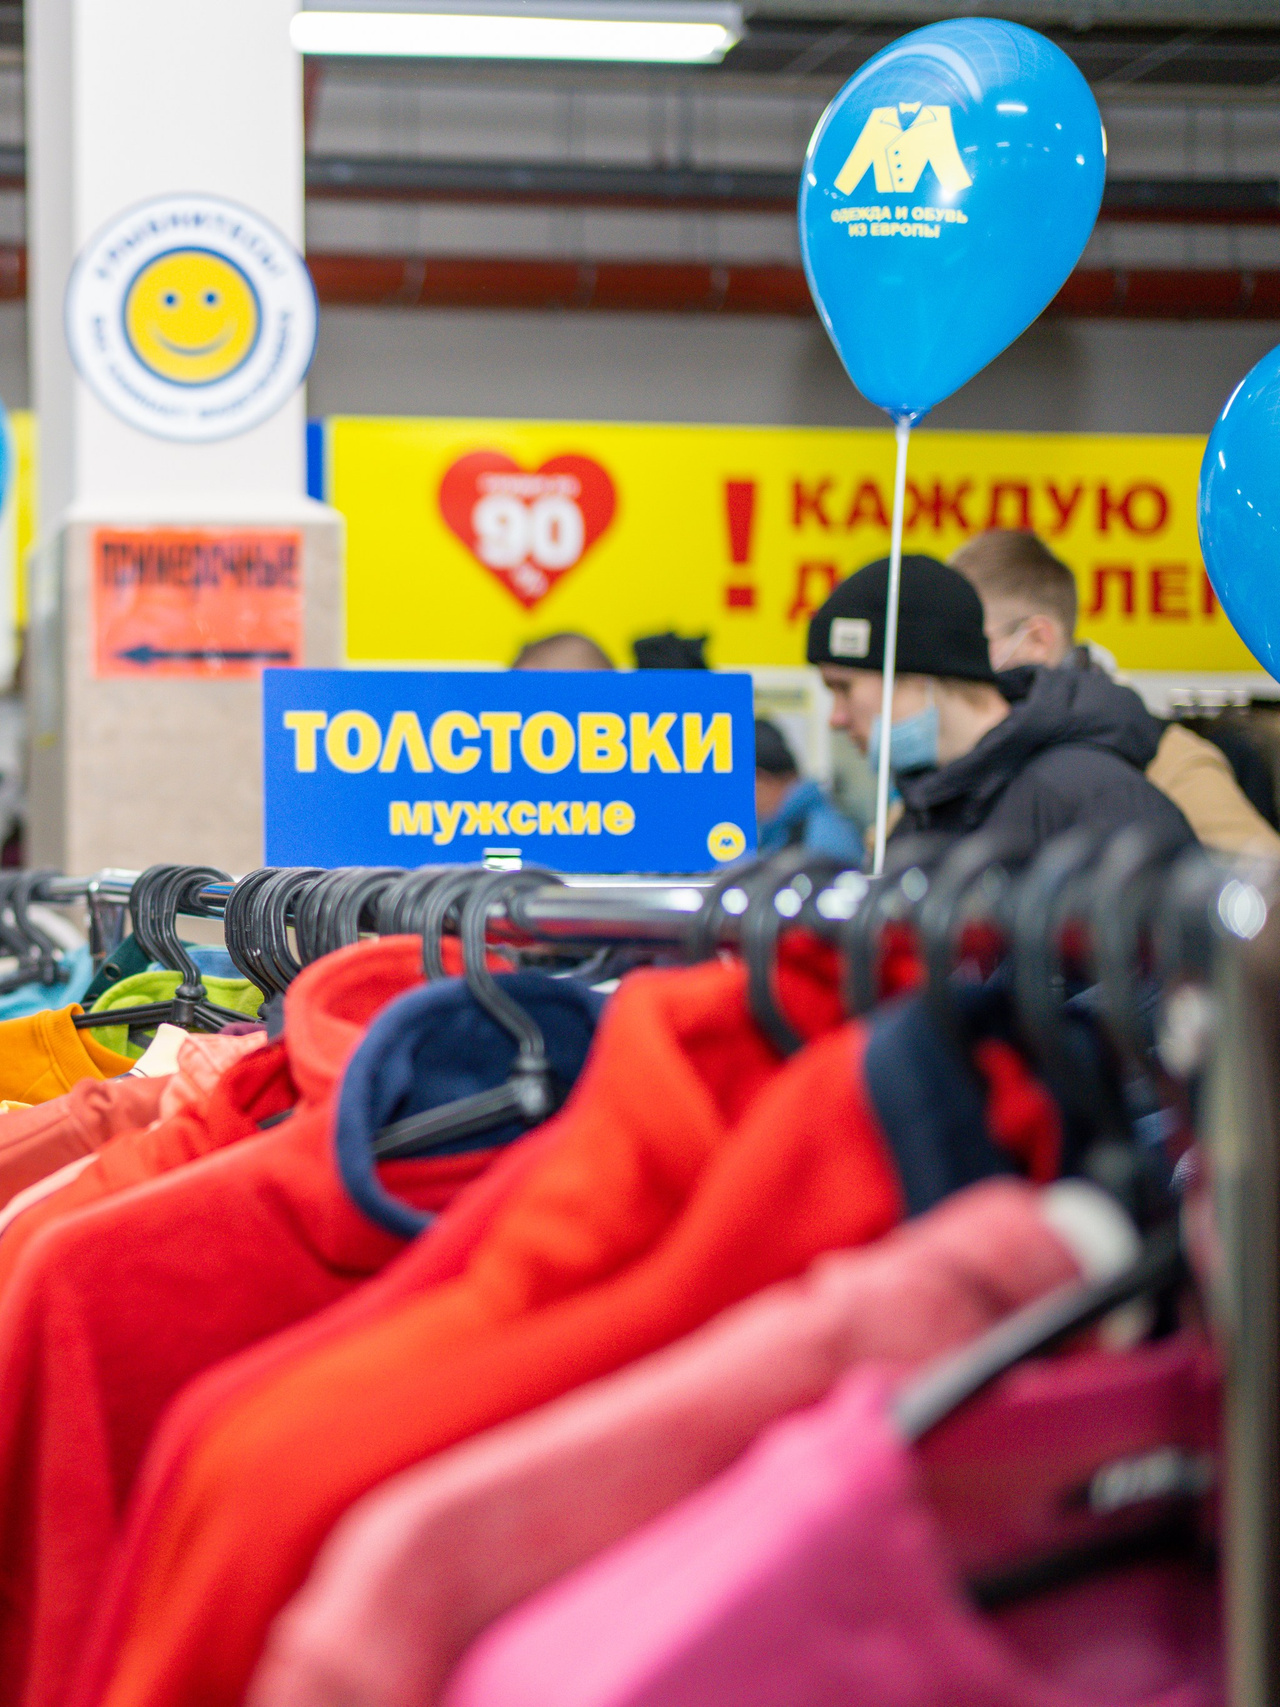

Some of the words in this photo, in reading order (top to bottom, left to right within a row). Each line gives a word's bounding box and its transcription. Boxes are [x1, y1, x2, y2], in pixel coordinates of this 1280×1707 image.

[831, 205, 892, 223] ОДЕЖДА
[894, 206, 908, 220] И
[911, 206, 969, 224] ОБУВЬ
[848, 223, 868, 238] ИЗ
[870, 222, 941, 239] ЕВРОПЫ
[472, 494, 586, 570] 90
[790, 474, 1173, 537] КАЖДУЮ
[284, 710, 734, 774] ТОЛСТОВКИ
[389, 800, 636, 846] мужские
